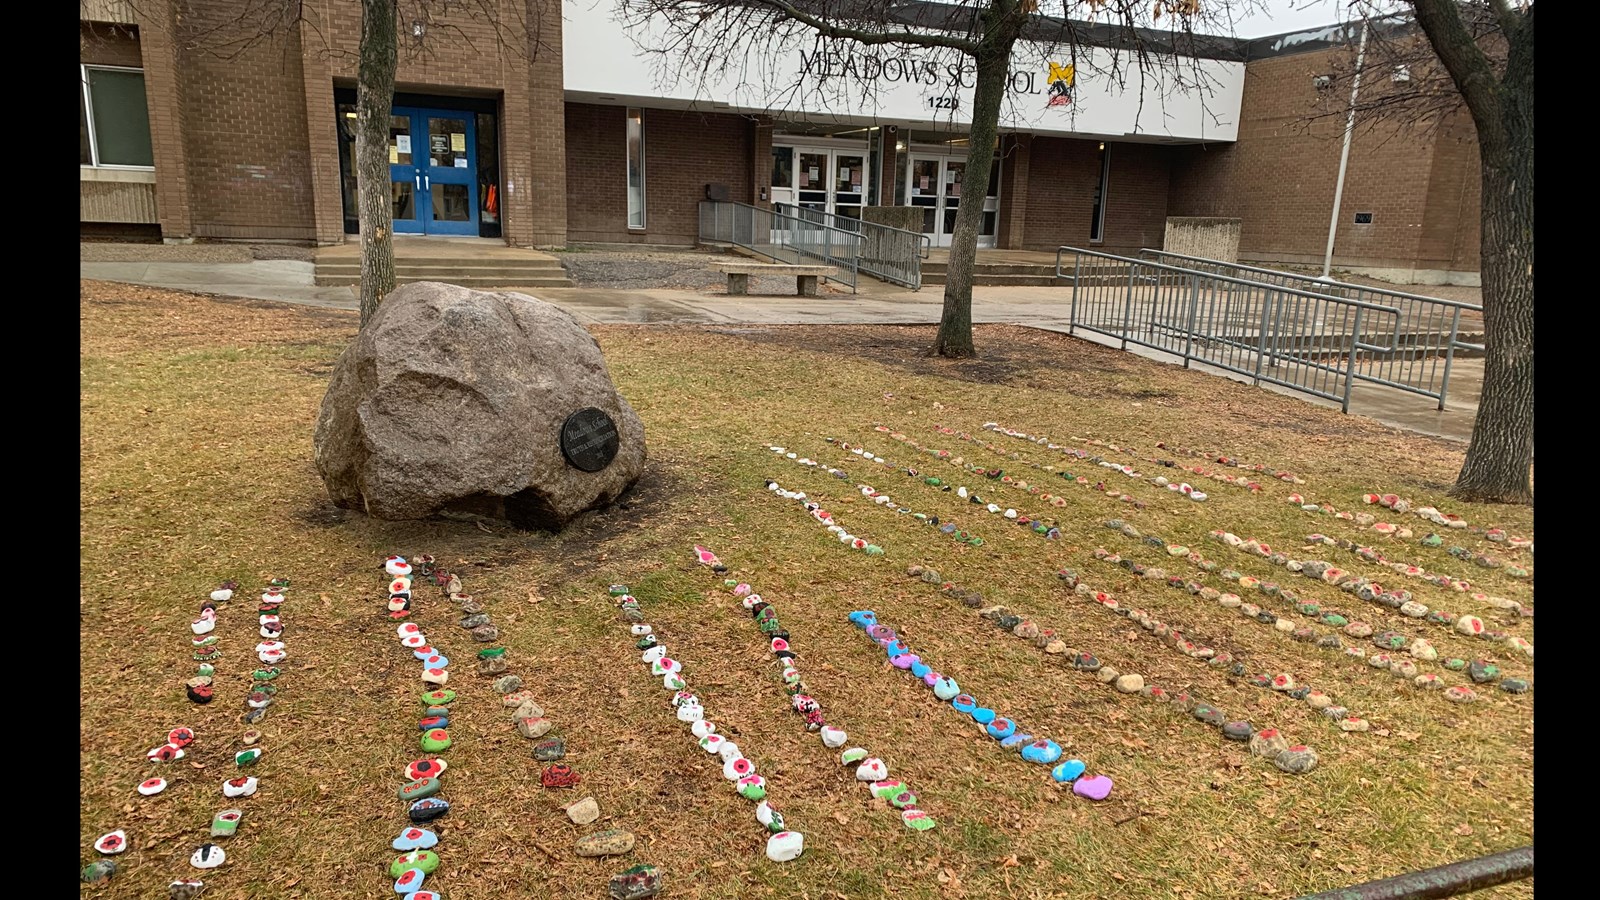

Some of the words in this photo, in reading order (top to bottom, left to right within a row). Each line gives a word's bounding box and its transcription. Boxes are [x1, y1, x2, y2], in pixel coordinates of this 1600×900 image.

[798, 50, 937, 85] MEADOWS
[947, 64, 1041, 94] SCOL
[928, 96, 959, 110] 1220
